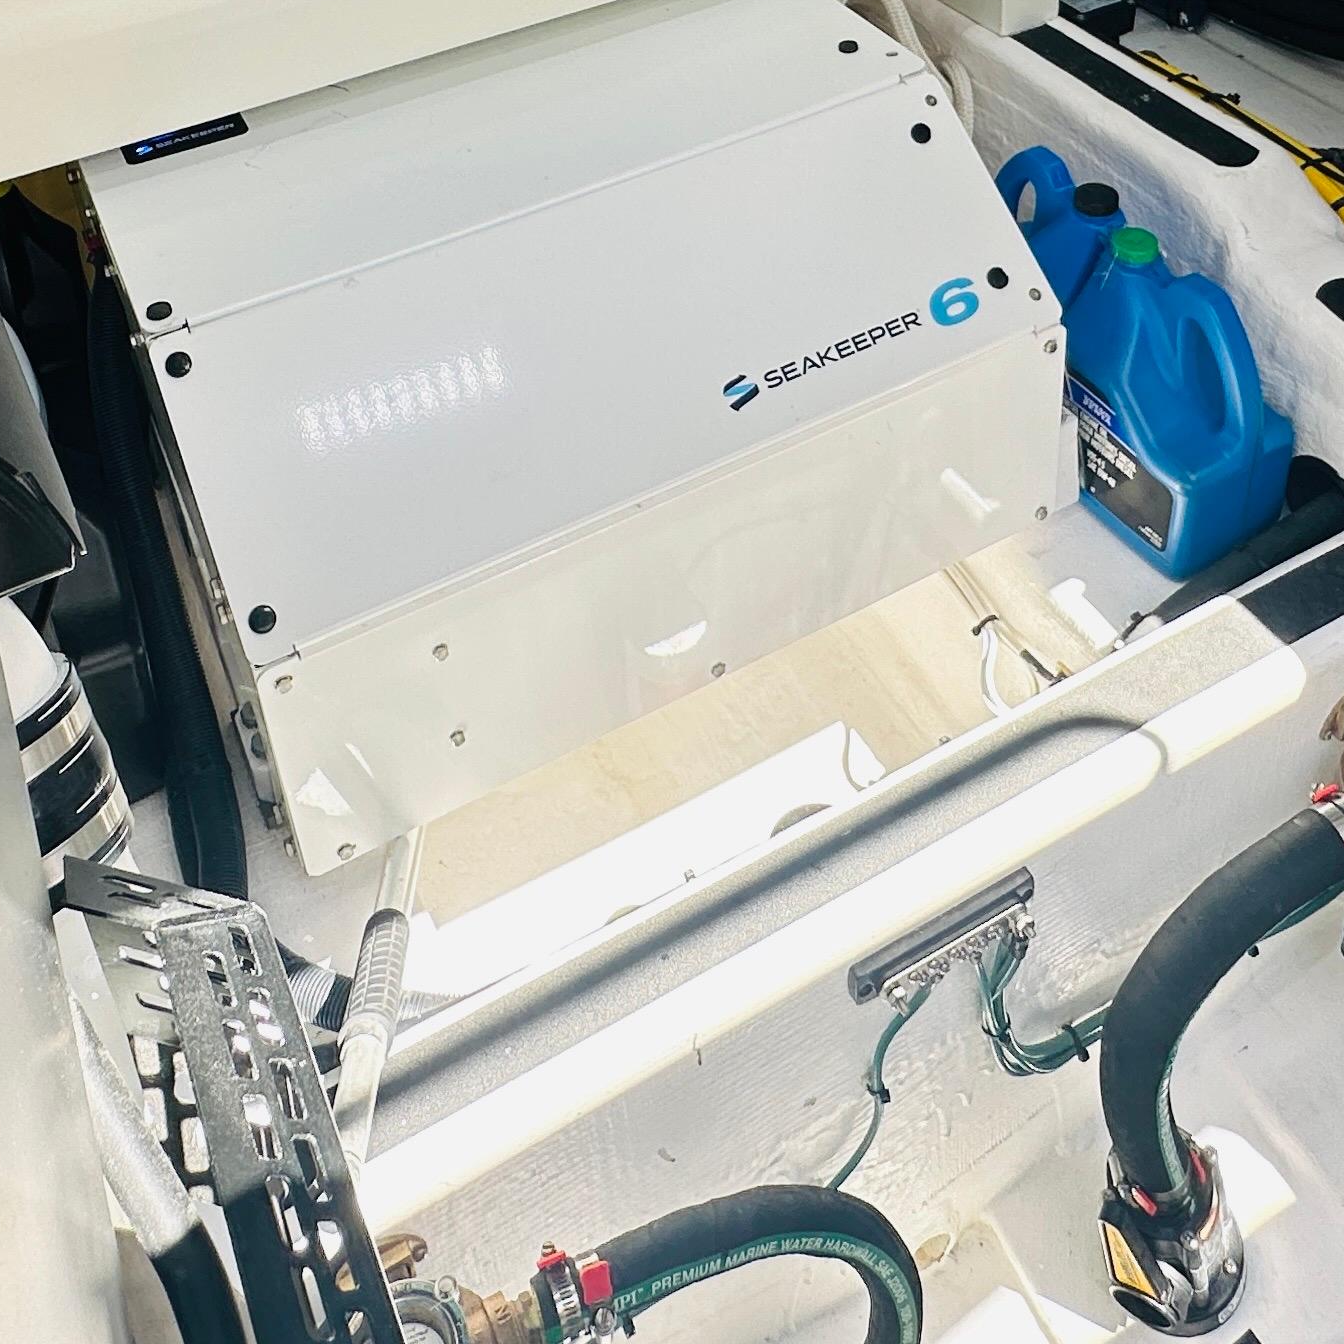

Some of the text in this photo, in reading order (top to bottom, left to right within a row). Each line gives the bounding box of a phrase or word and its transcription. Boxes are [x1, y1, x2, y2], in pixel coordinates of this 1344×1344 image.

[155, 122, 235, 150] SEAKEEPER
[763, 277, 981, 389] SEAKEEPER 6
[651, 1259, 722, 1295] PREMIUM
[724, 1240, 778, 1268] MARINE
[779, 1237, 822, 1251] WATER
[821, 1239, 879, 1268] HARDWALL
